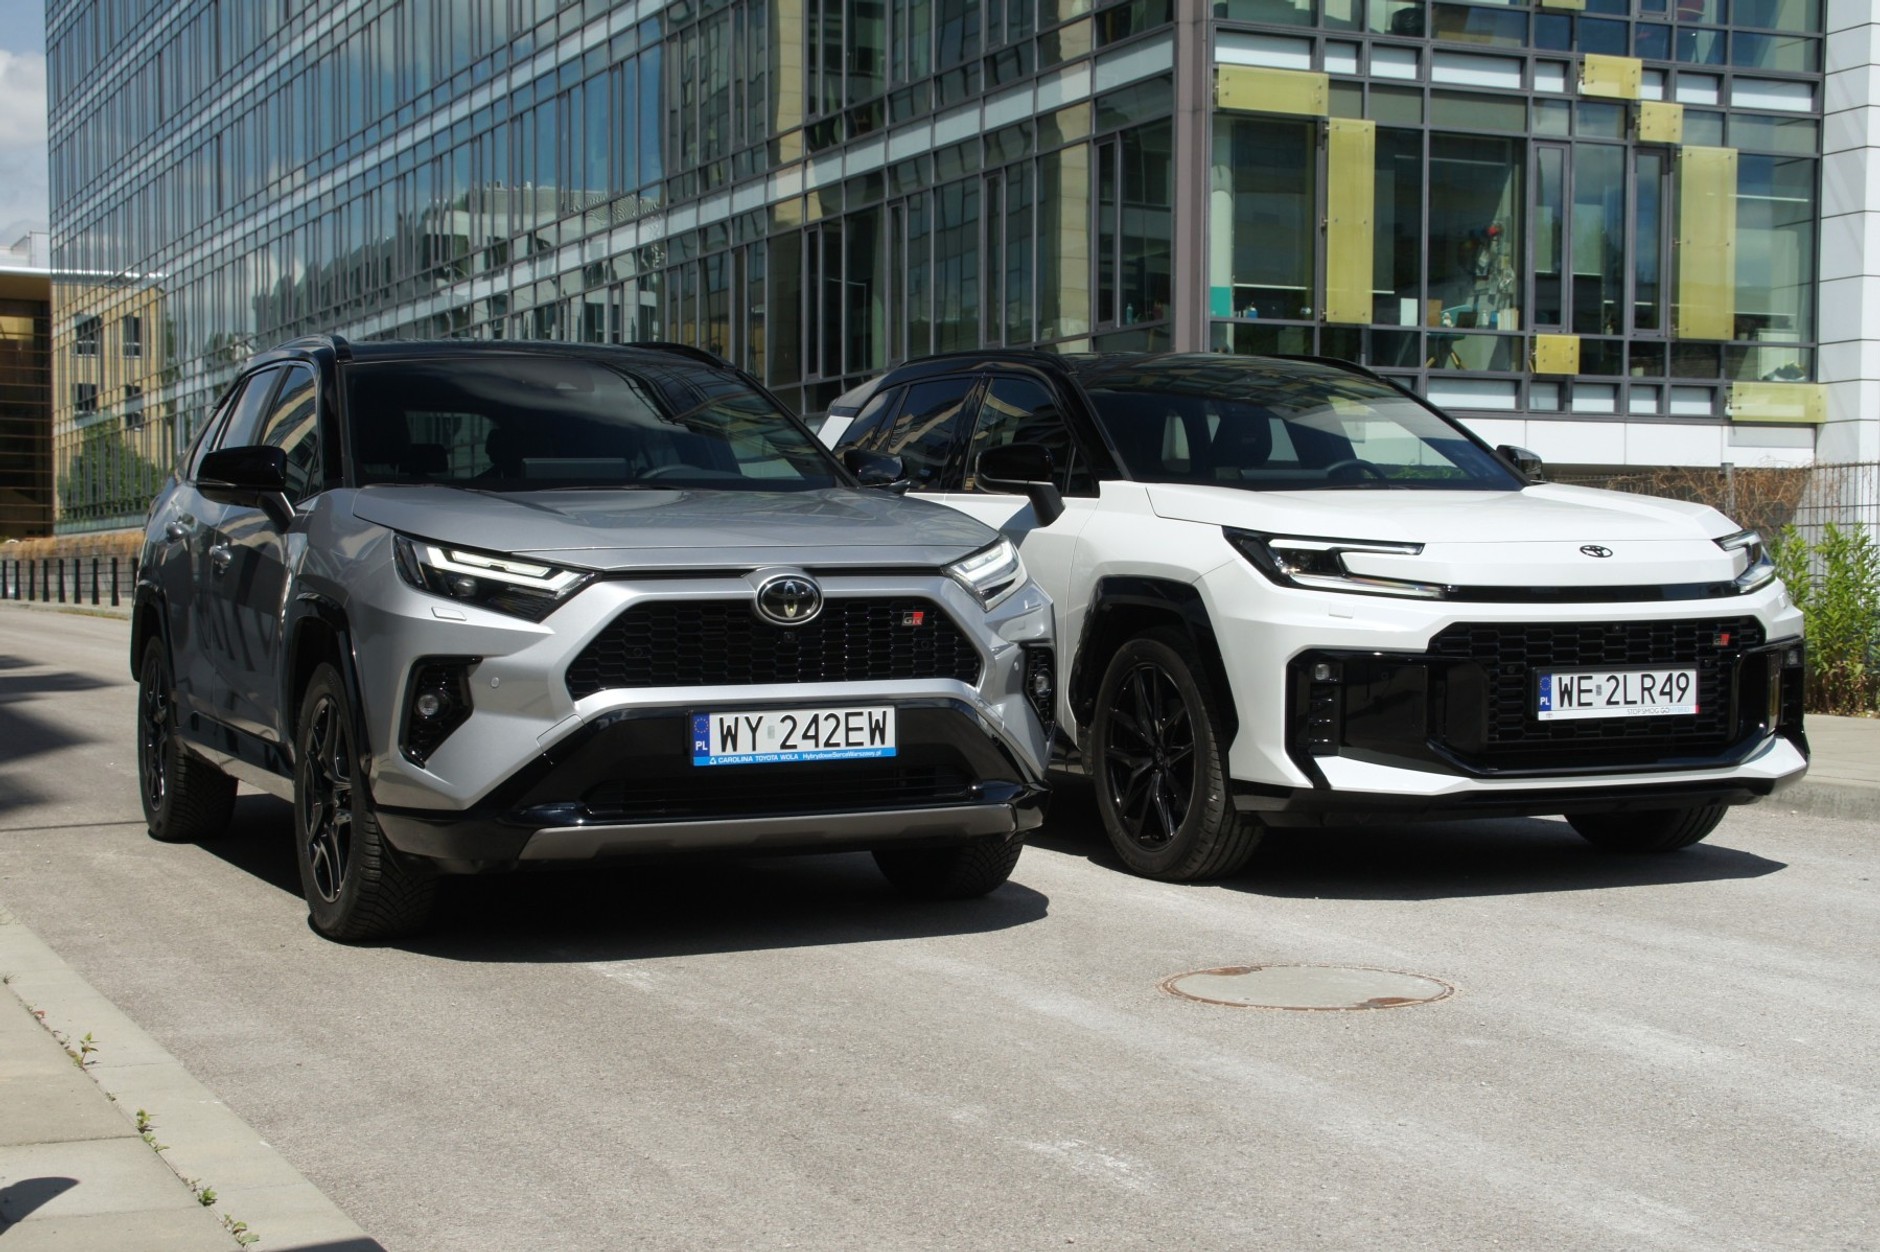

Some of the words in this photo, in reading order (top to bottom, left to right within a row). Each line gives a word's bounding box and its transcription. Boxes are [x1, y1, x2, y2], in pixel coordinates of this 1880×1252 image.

[902, 614, 923, 625] GR
[1558, 675, 1593, 707] WE
[1605, 672, 1690, 706] 2LR49
[1540, 697, 1550, 706] PL
[719, 715, 764, 753] WY
[779, 710, 887, 750] 242EW
[695, 741, 708, 751] PL
[717, 756, 753, 764] CAROLINA
[755, 754, 778, 762] TOYOTA
[780, 753, 799, 761] WOLA
